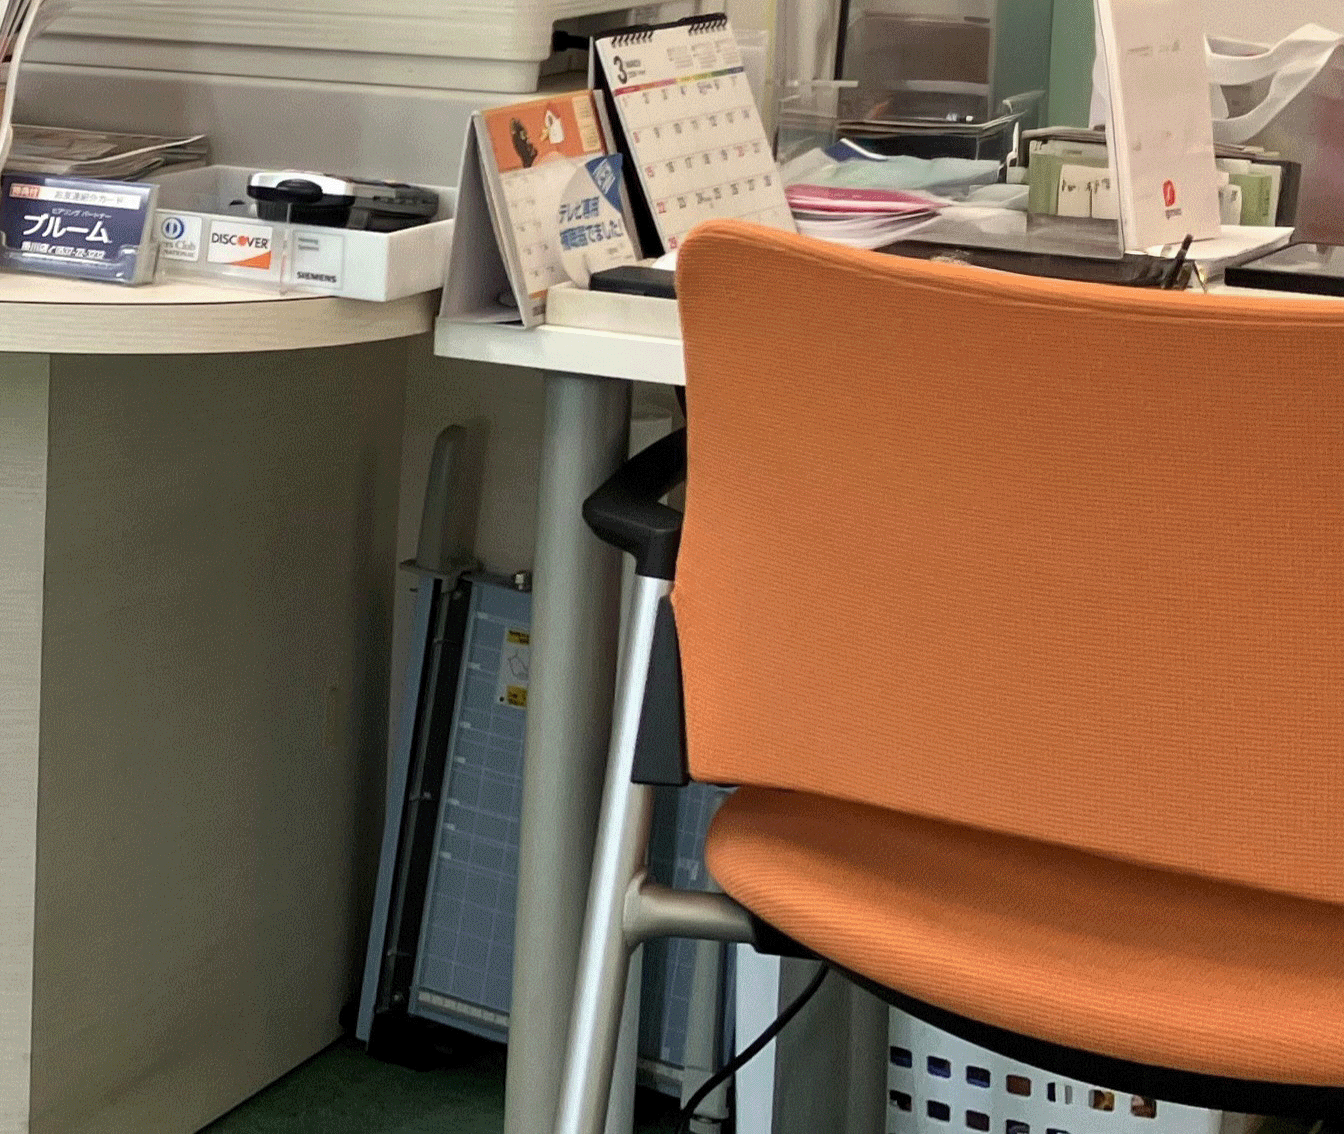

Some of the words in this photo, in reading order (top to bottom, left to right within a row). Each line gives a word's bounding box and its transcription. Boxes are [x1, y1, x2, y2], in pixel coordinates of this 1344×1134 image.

[614, 56, 628, 84] 3
[23, 212, 113, 244] ブルーム
[211, 232, 269, 249] DISCOVER
[297, 271, 337, 283] SIEMENS
